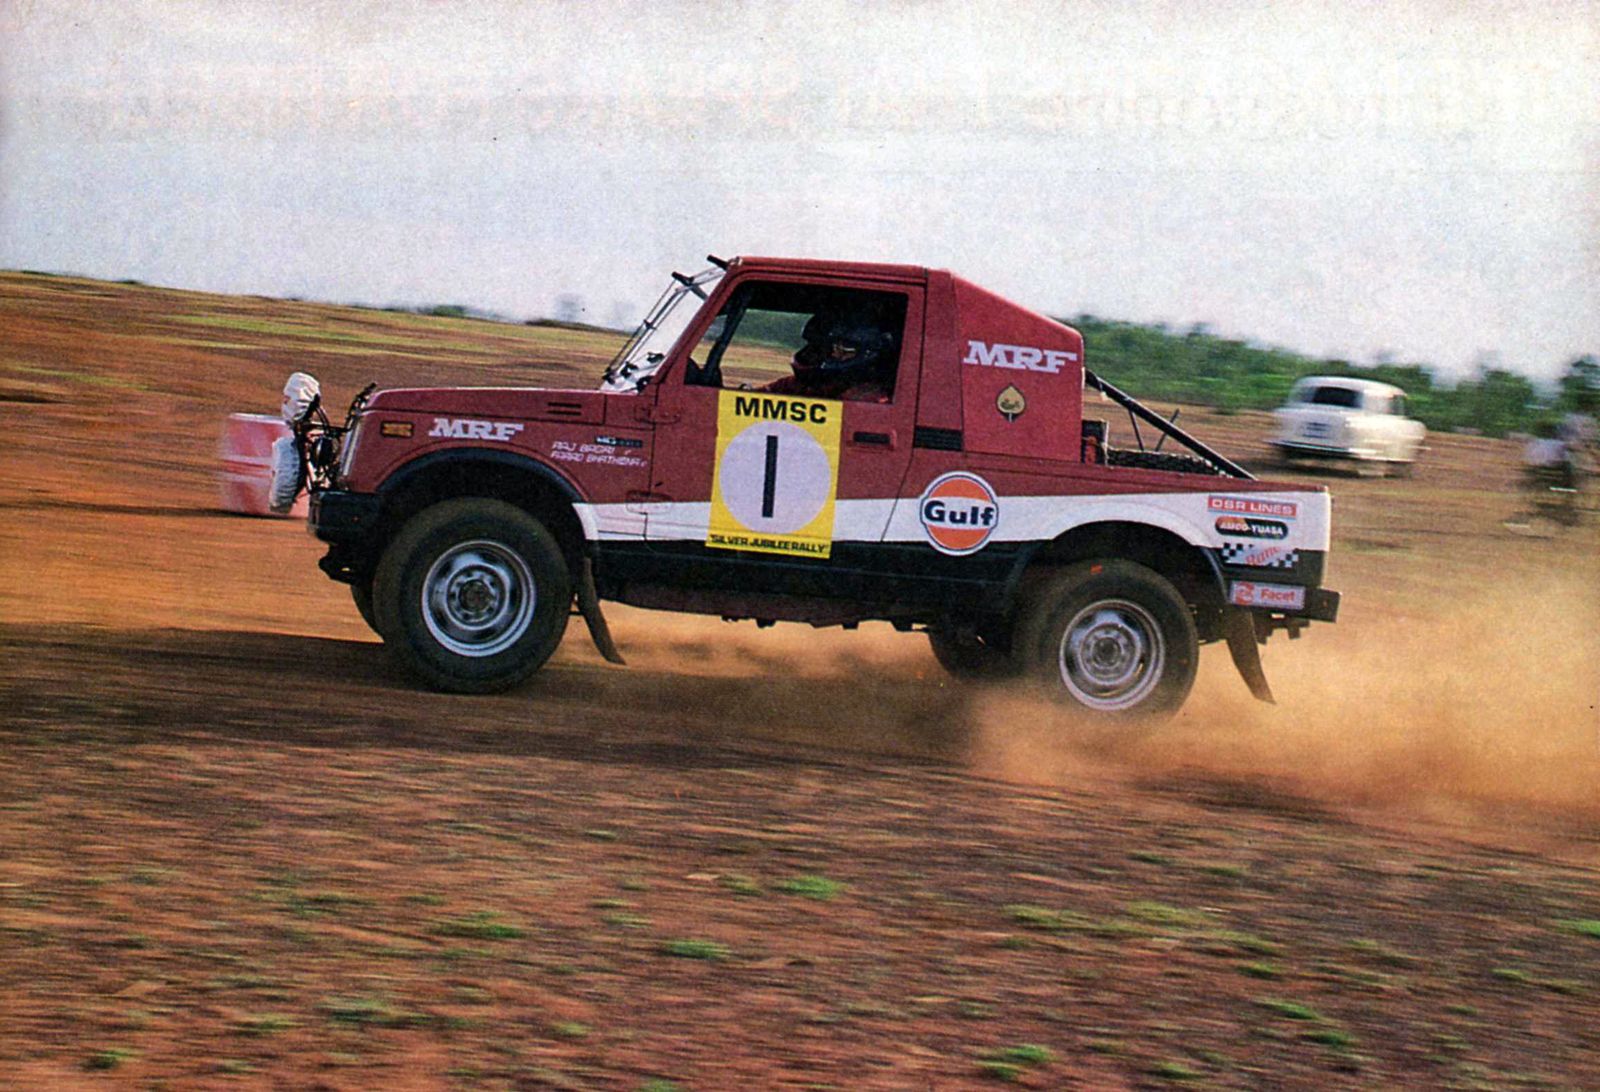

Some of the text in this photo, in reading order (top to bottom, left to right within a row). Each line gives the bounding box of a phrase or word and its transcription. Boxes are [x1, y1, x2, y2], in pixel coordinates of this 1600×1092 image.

[963, 340, 1077, 374] MRF
[735, 396, 828, 424] MMSC
[428, 418, 524, 441] MRF
[924, 500, 995, 526] Gulf
[1250, 502, 1293, 515] LINES
[1261, 588, 1296, 602] Facet
